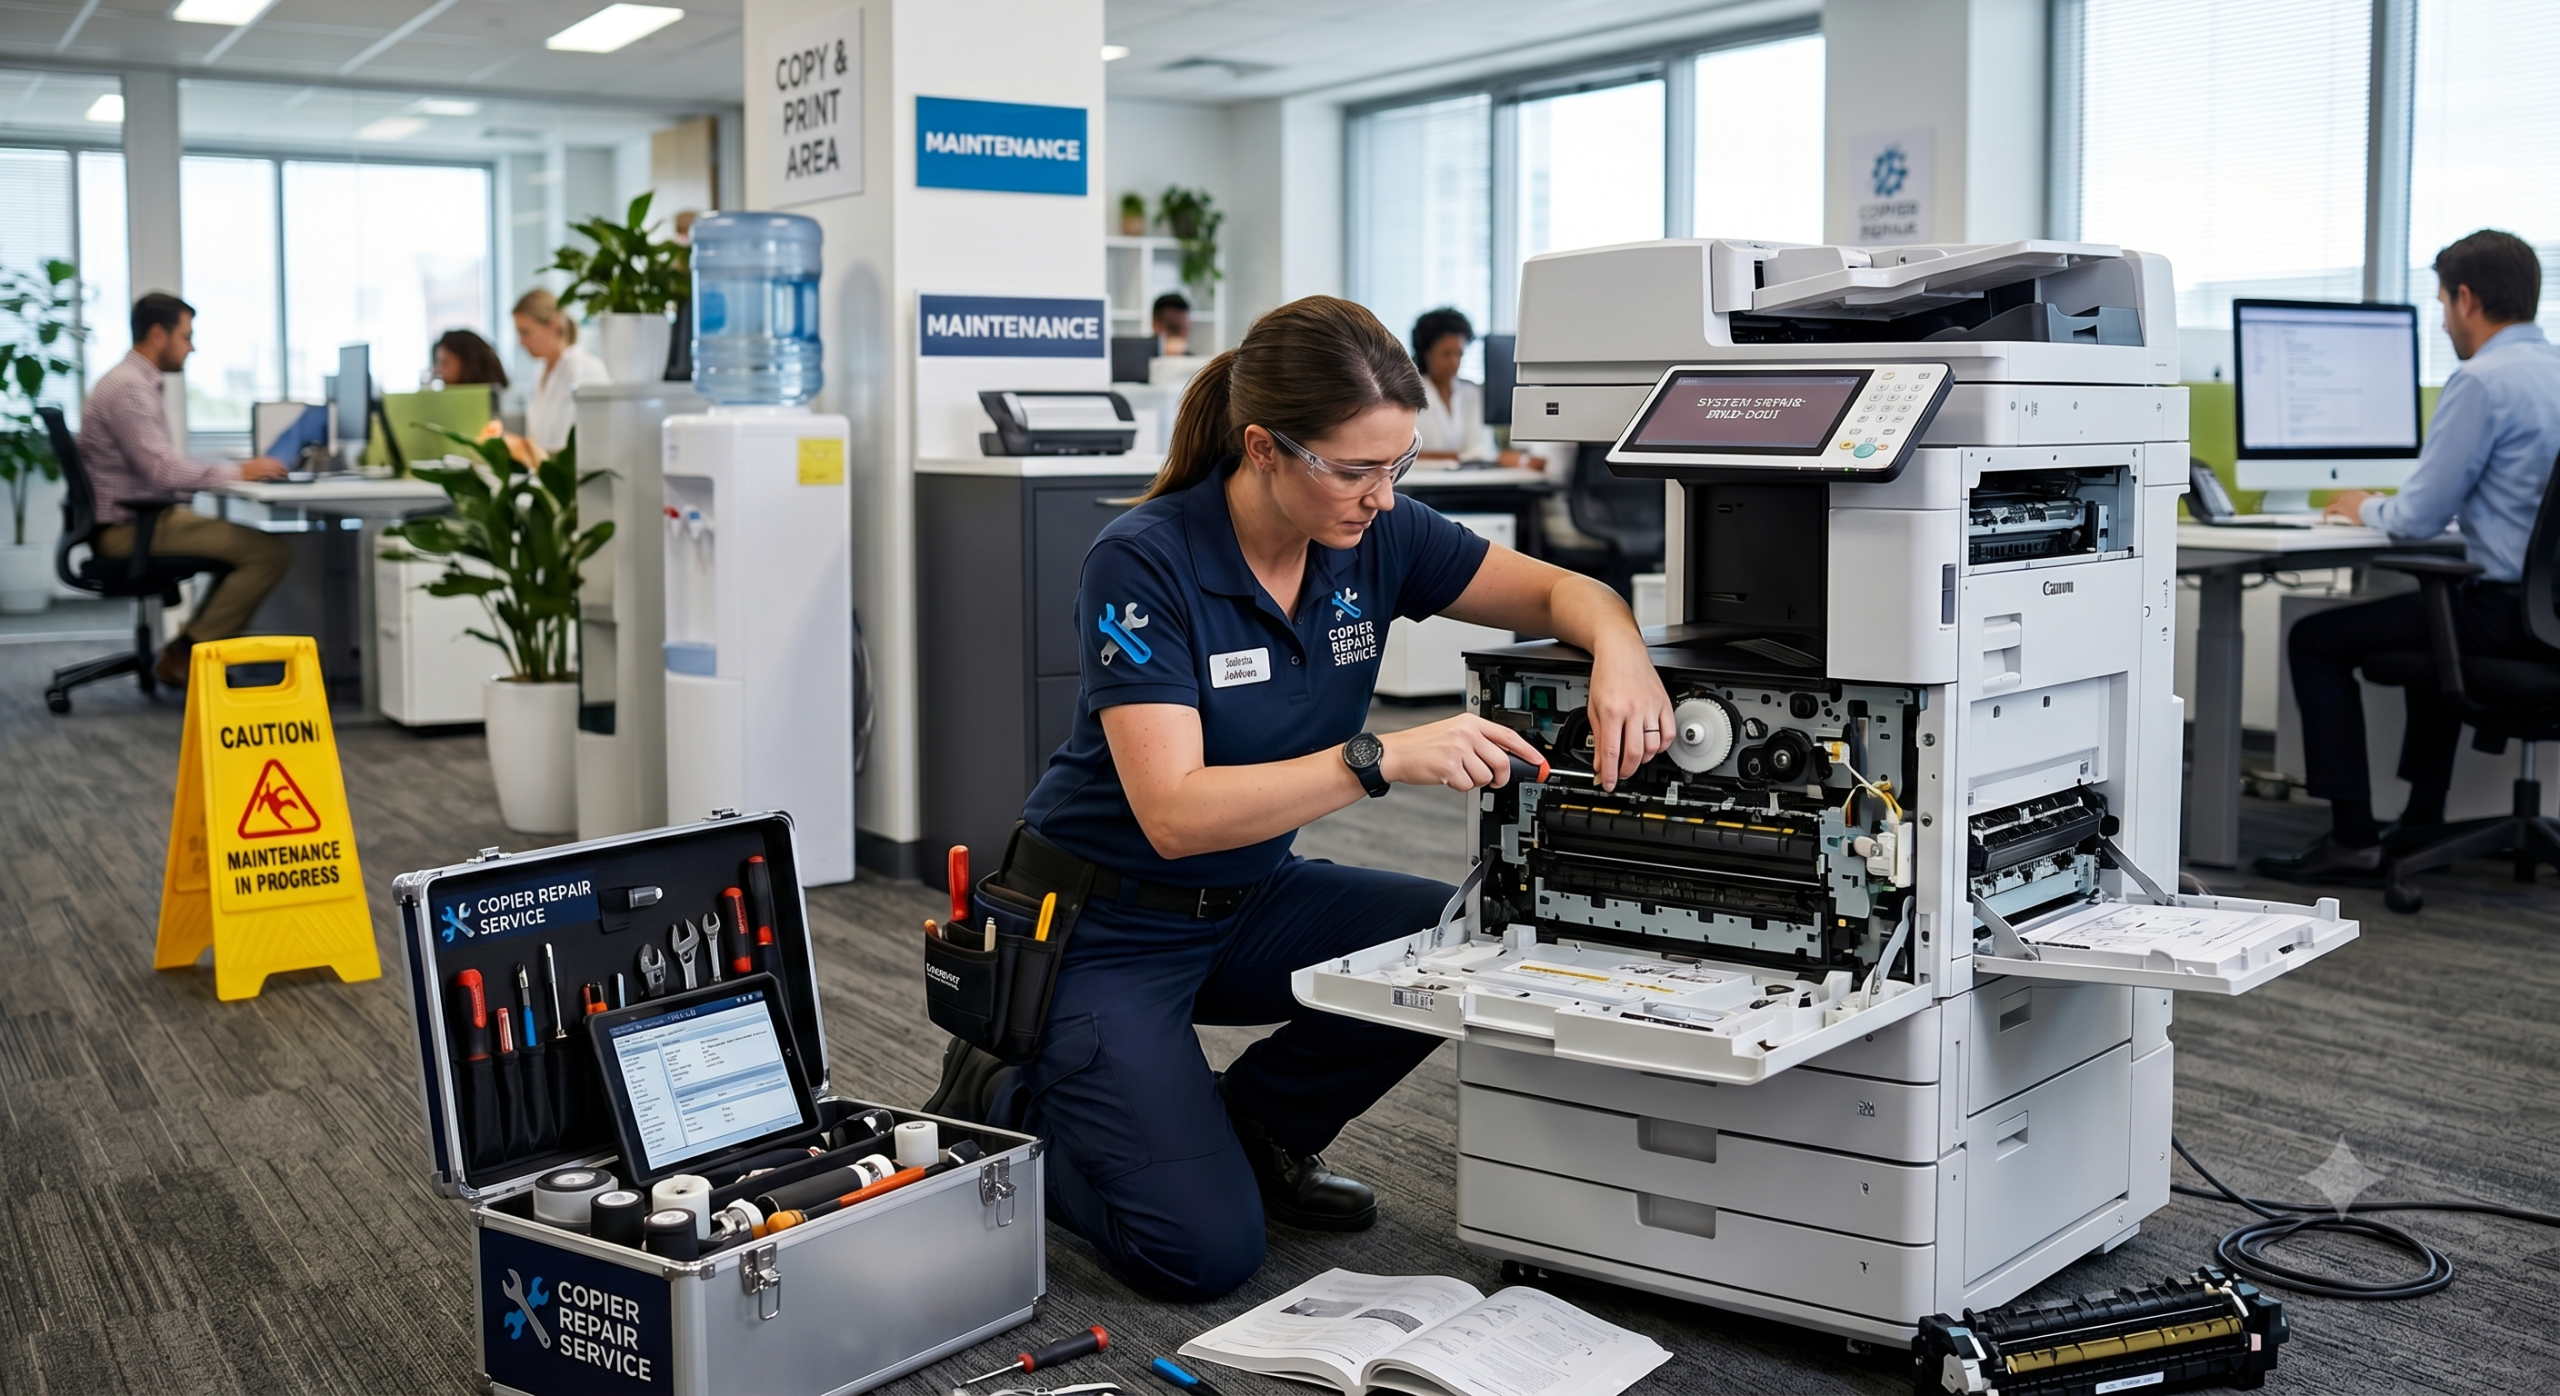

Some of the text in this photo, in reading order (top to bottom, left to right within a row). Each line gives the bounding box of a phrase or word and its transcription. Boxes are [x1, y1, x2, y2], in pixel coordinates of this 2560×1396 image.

[776, 38, 848, 91] COPY &
[783, 89, 841, 136] PRINT
[785, 136, 840, 182] AREA
[925, 131, 1080, 162] MAINTENANCE
[927, 313, 1099, 341] MAINTENANCE
[1328, 620, 1375, 641] COPIER
[1331, 633, 1376, 654] REPAIR
[1334, 644, 1378, 667] SERVICE
[228, 840, 341, 871] MAINTENANCE
[235, 865, 340, 895] IN PROGRESS
[477, 880, 592, 915] COPIER REPAIR
[480, 907, 546, 935] SERVICE
[558, 1281, 640, 1325] COPIER
[559, 1306, 639, 1351] REPAIR
[560, 1334, 652, 1382] SERVICE
